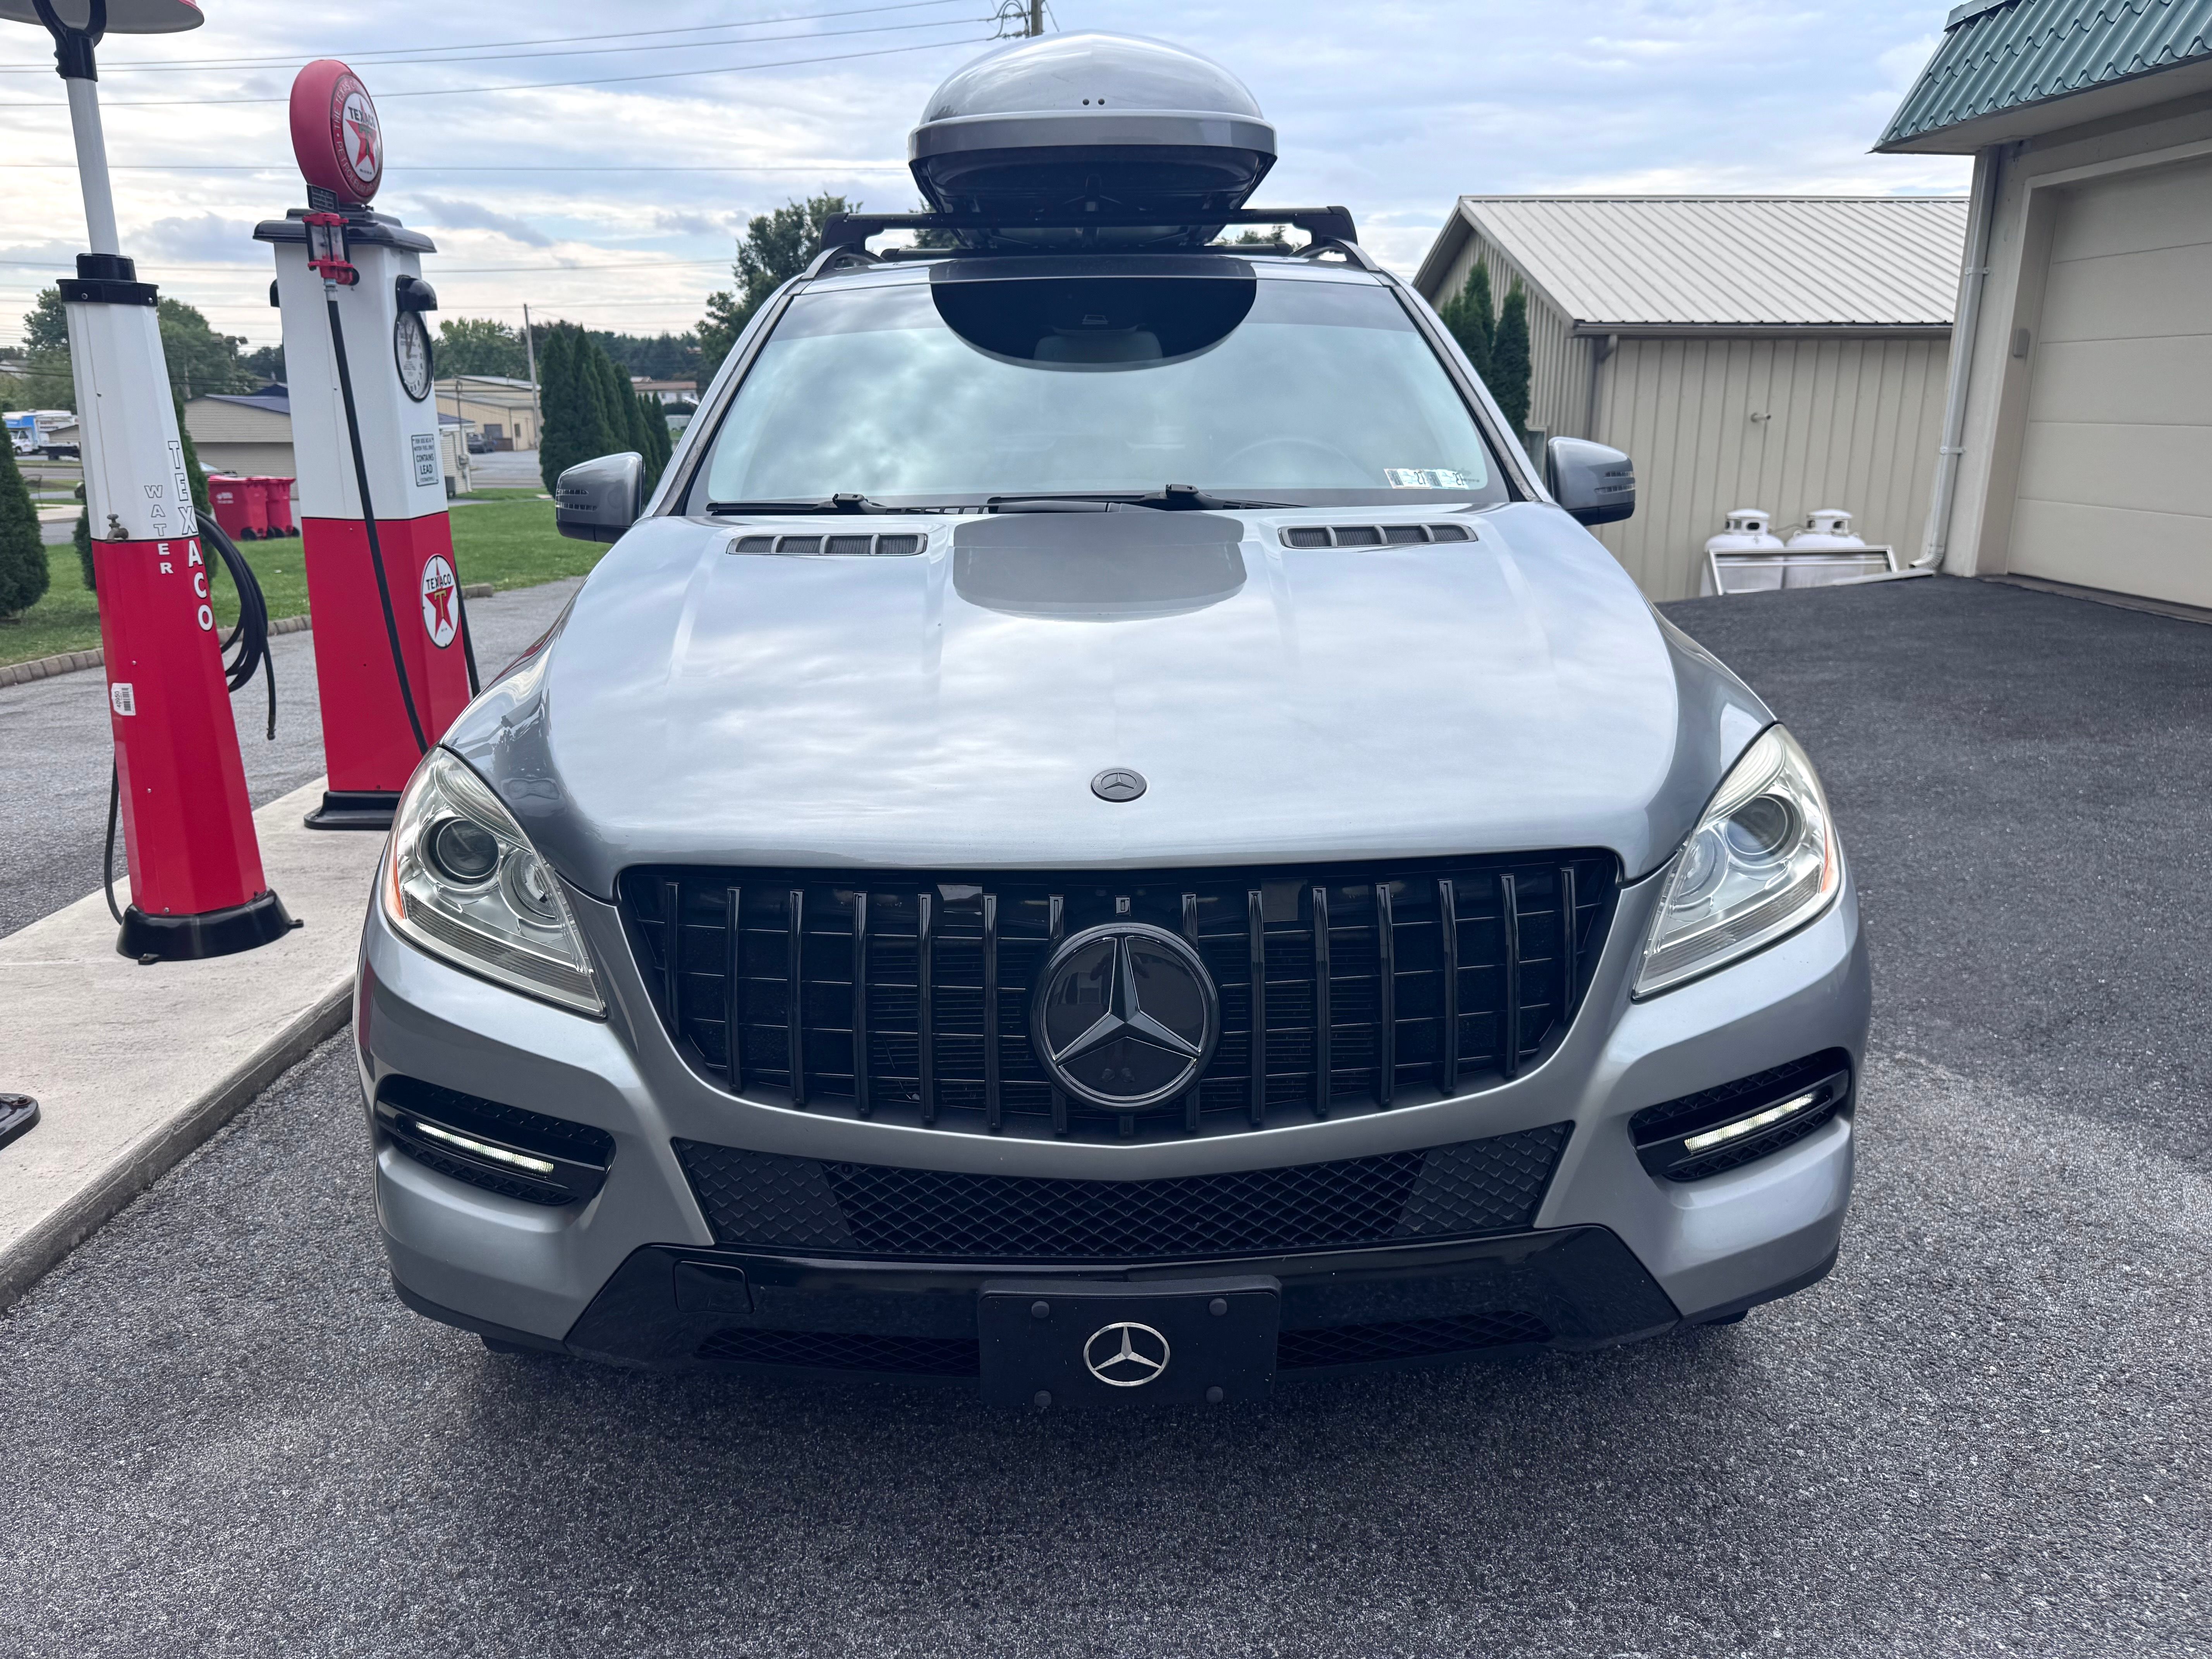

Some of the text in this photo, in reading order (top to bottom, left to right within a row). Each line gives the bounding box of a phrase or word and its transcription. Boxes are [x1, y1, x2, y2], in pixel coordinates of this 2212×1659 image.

[416, 453, 434, 462] CONTAINS
[420, 464, 433, 475] LEAD
[144, 485, 174, 574] WATER
[168, 441, 213, 631] TEXACO
[426, 574, 451, 591] TEXACO
